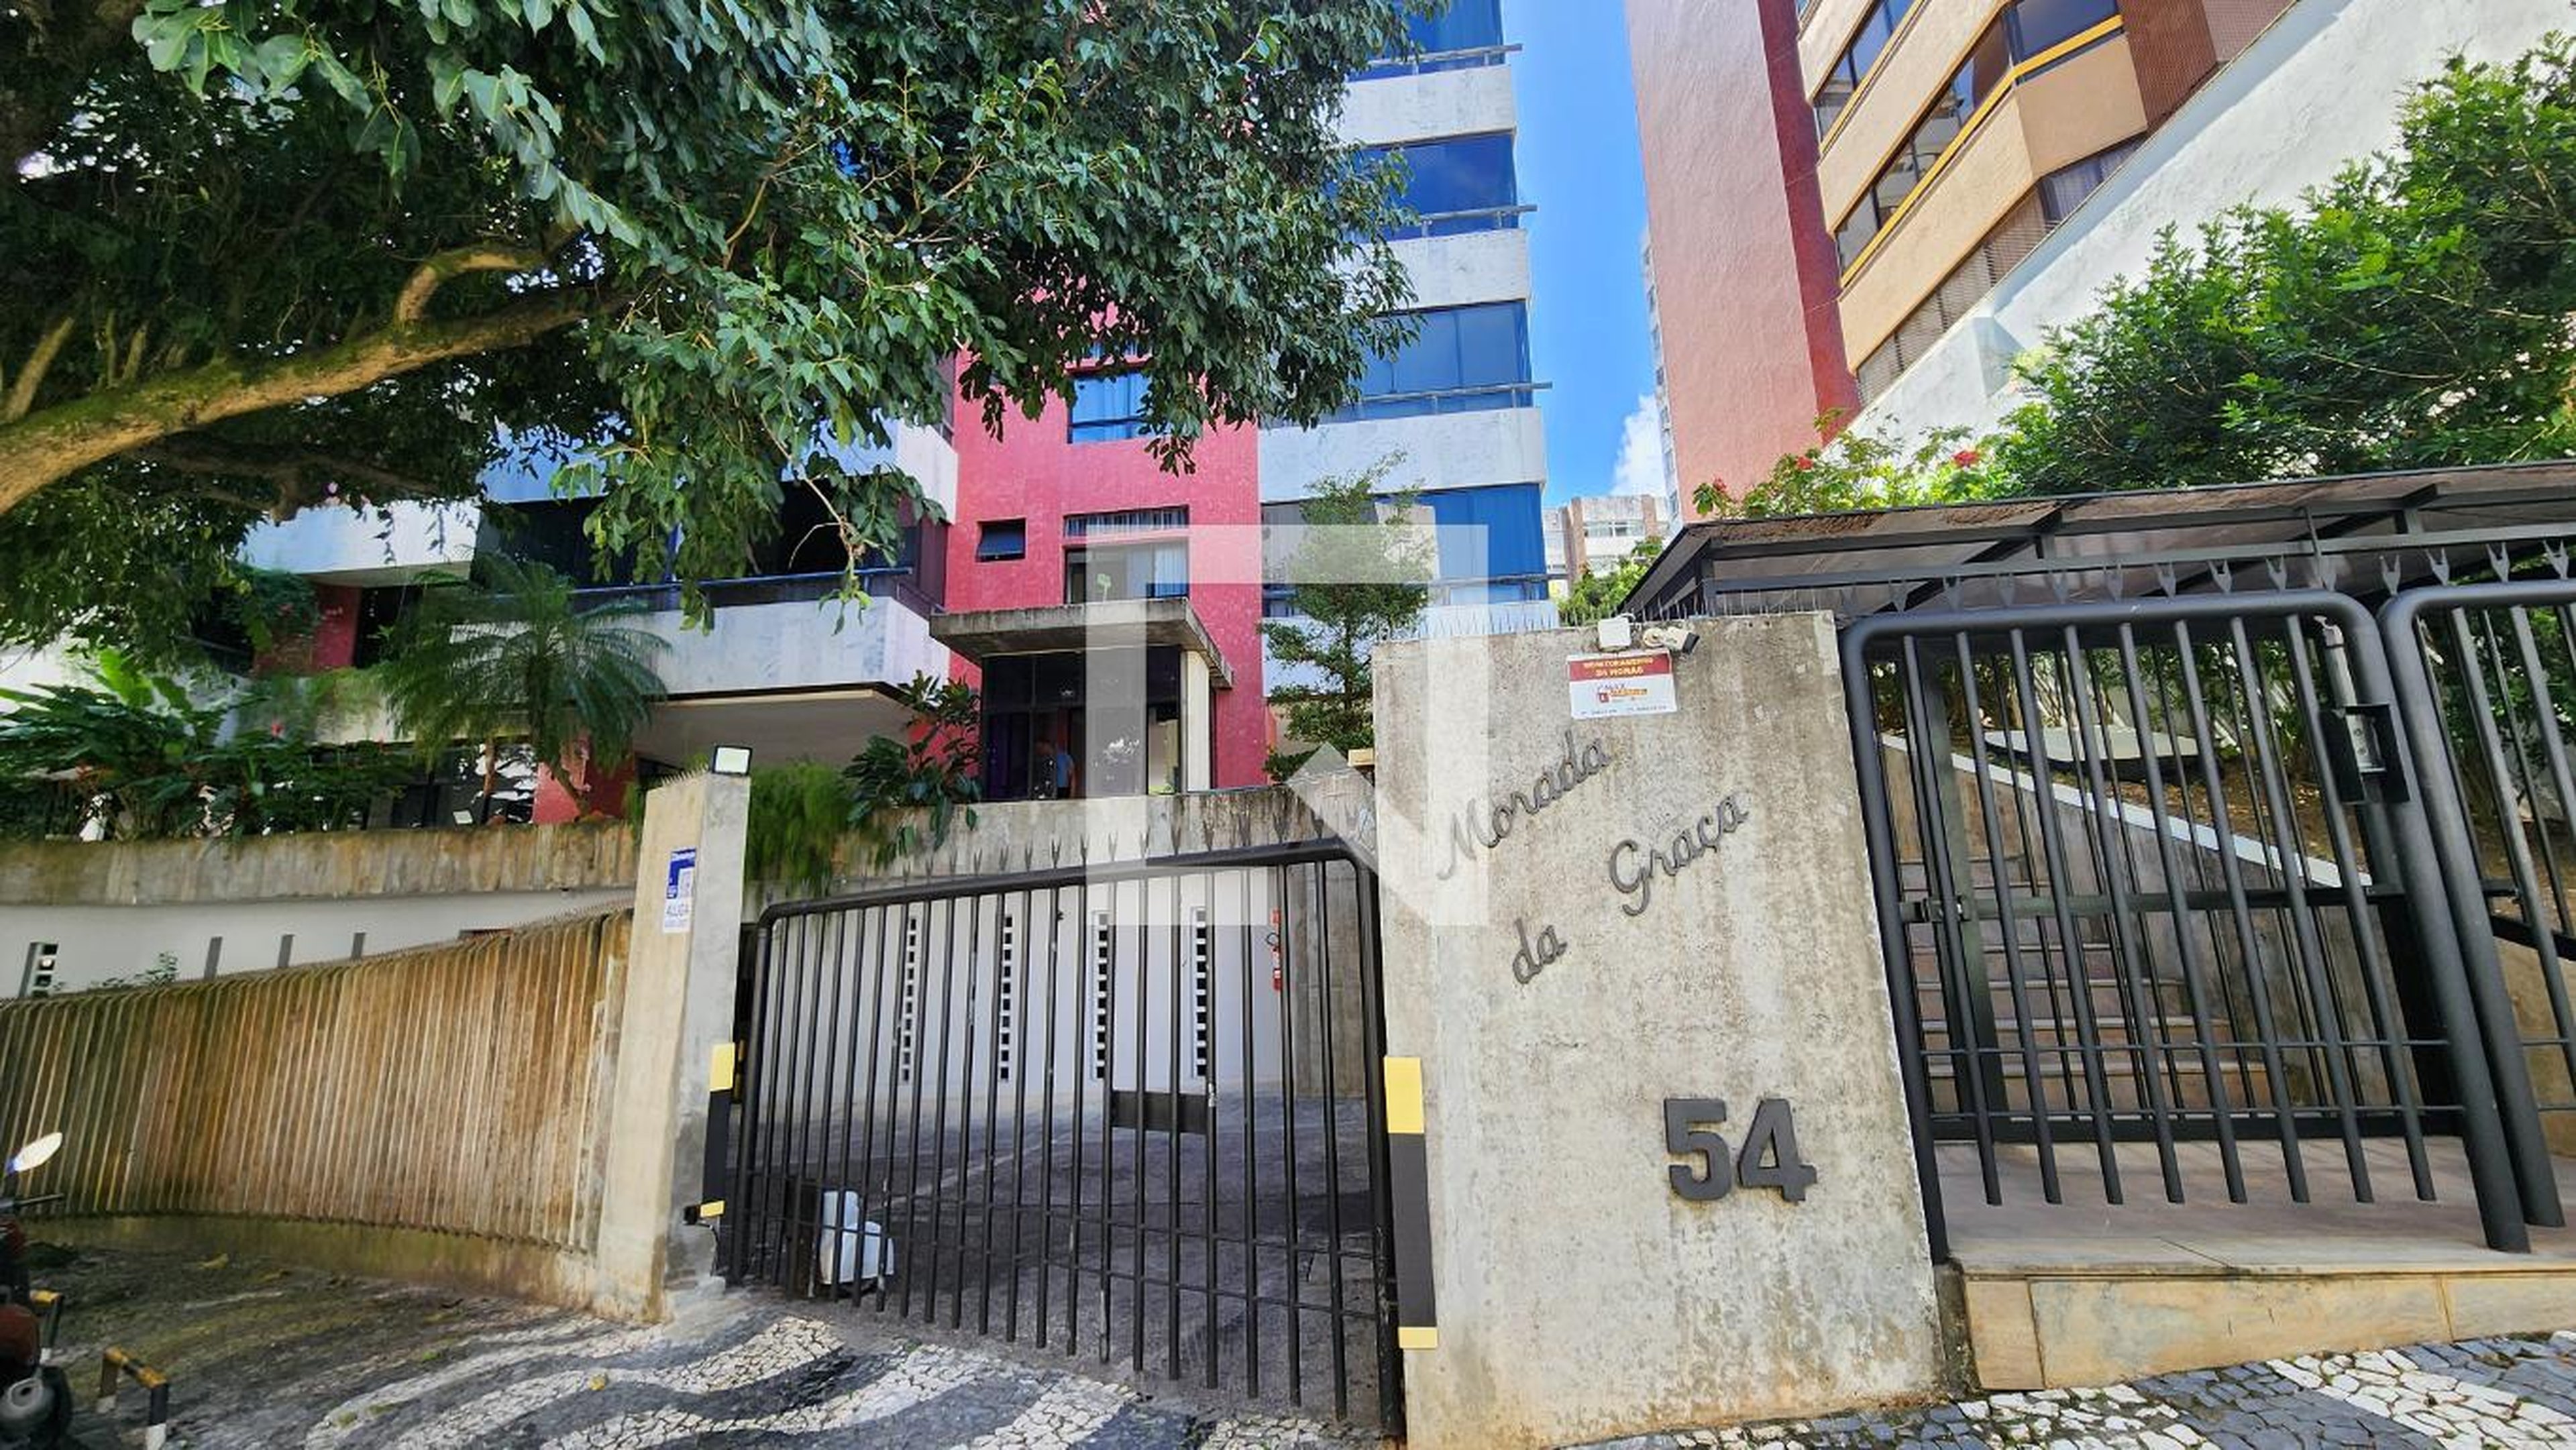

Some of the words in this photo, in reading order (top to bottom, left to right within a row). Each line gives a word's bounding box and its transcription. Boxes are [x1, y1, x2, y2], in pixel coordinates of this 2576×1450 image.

[1610, 666, 1644, 676] HORAS
[1436, 730, 1611, 880] Morada
[1512, 917, 1567, 985] da
[1610, 794, 1750, 917] Graça
[1664, 1098, 1817, 1202] 54
